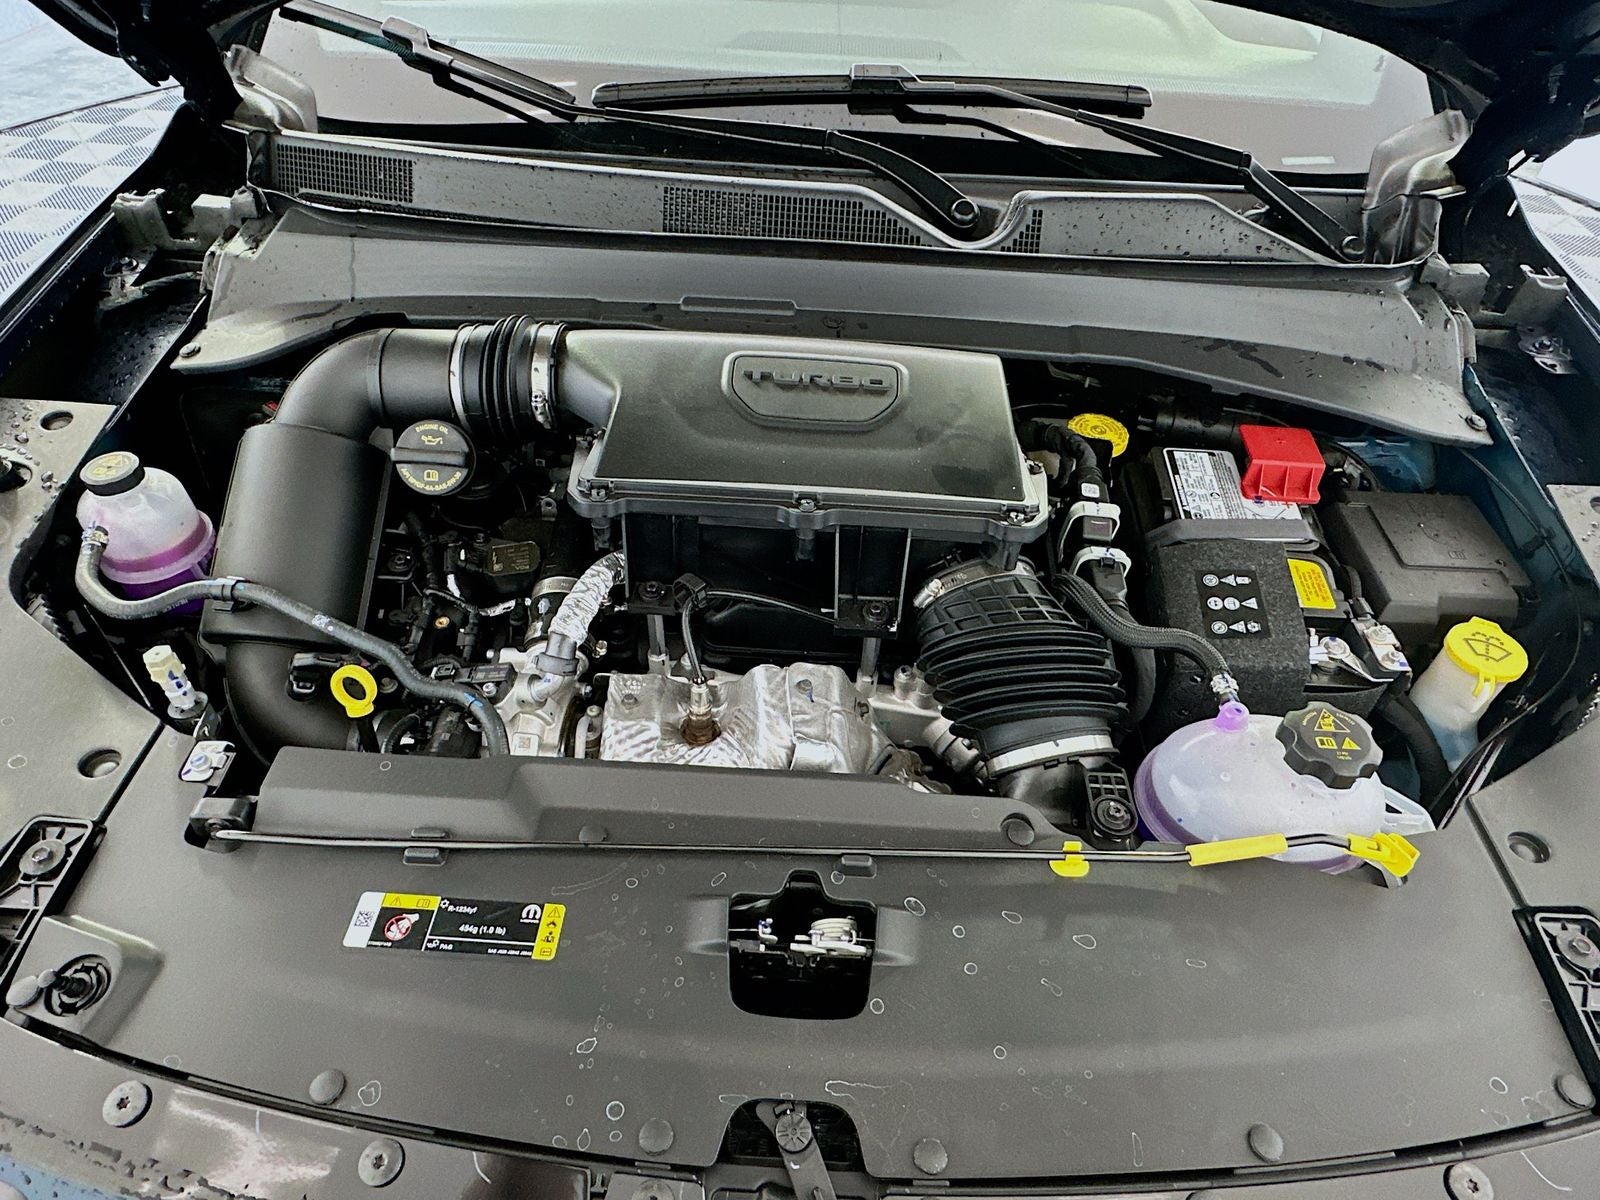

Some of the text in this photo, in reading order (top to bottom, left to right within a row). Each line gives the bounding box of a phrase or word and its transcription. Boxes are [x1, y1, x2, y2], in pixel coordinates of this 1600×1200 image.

[743, 368, 891, 392] TURBO
[415, 424, 449, 435] ENGINE OIL
[447, 905, 478, 915] R-1234yf
[458, 923, 506, 936] 454g (1.0 lb)
